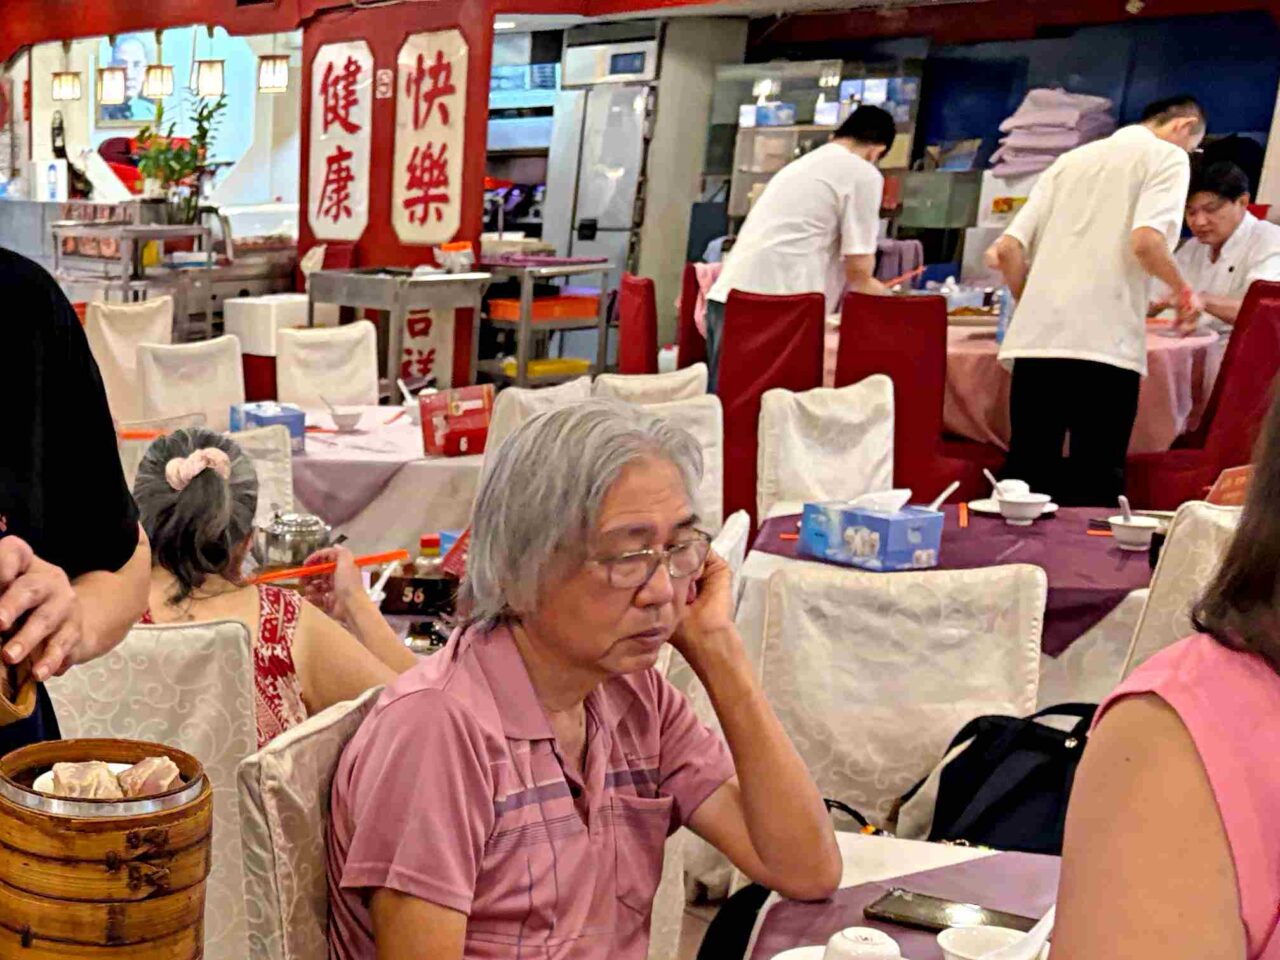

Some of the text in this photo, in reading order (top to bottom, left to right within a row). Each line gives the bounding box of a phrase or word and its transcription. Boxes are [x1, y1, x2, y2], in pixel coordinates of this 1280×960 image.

[317, 56, 362, 223] 健康
[403, 50, 456, 227] 快樂
[402, 586, 424, 603] 56
